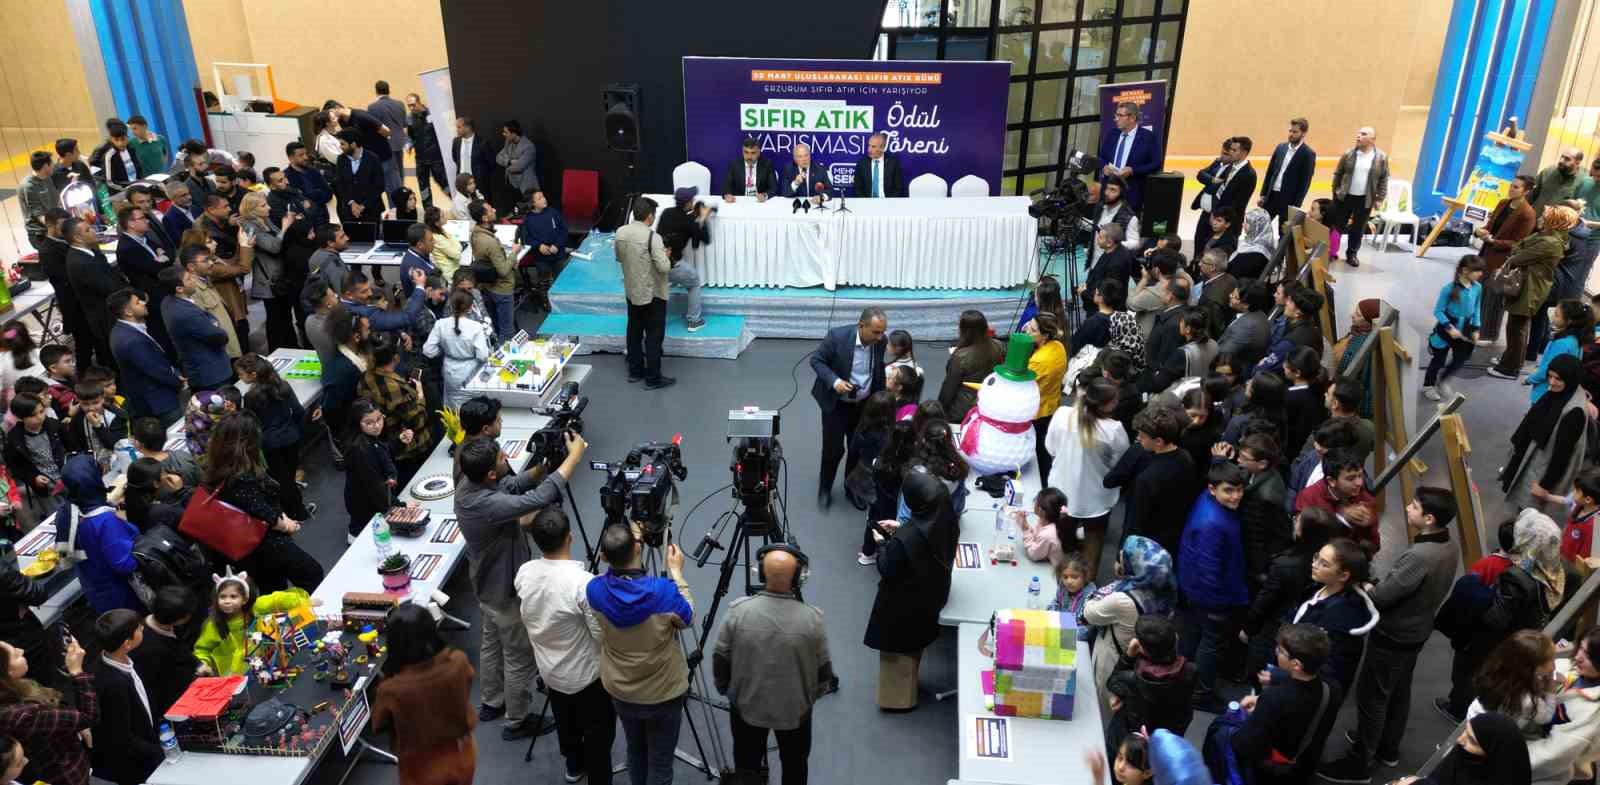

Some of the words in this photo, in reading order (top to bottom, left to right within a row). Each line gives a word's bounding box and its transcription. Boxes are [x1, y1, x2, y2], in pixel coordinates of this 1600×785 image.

[764, 84, 808, 93] ERZURUM
[836, 86, 856, 94] ATIK
[744, 108, 807, 128] SIFIR
[815, 110, 870, 129] ATIK
[887, 100, 941, 128] Ödül
[880, 130, 949, 154] Töreni
